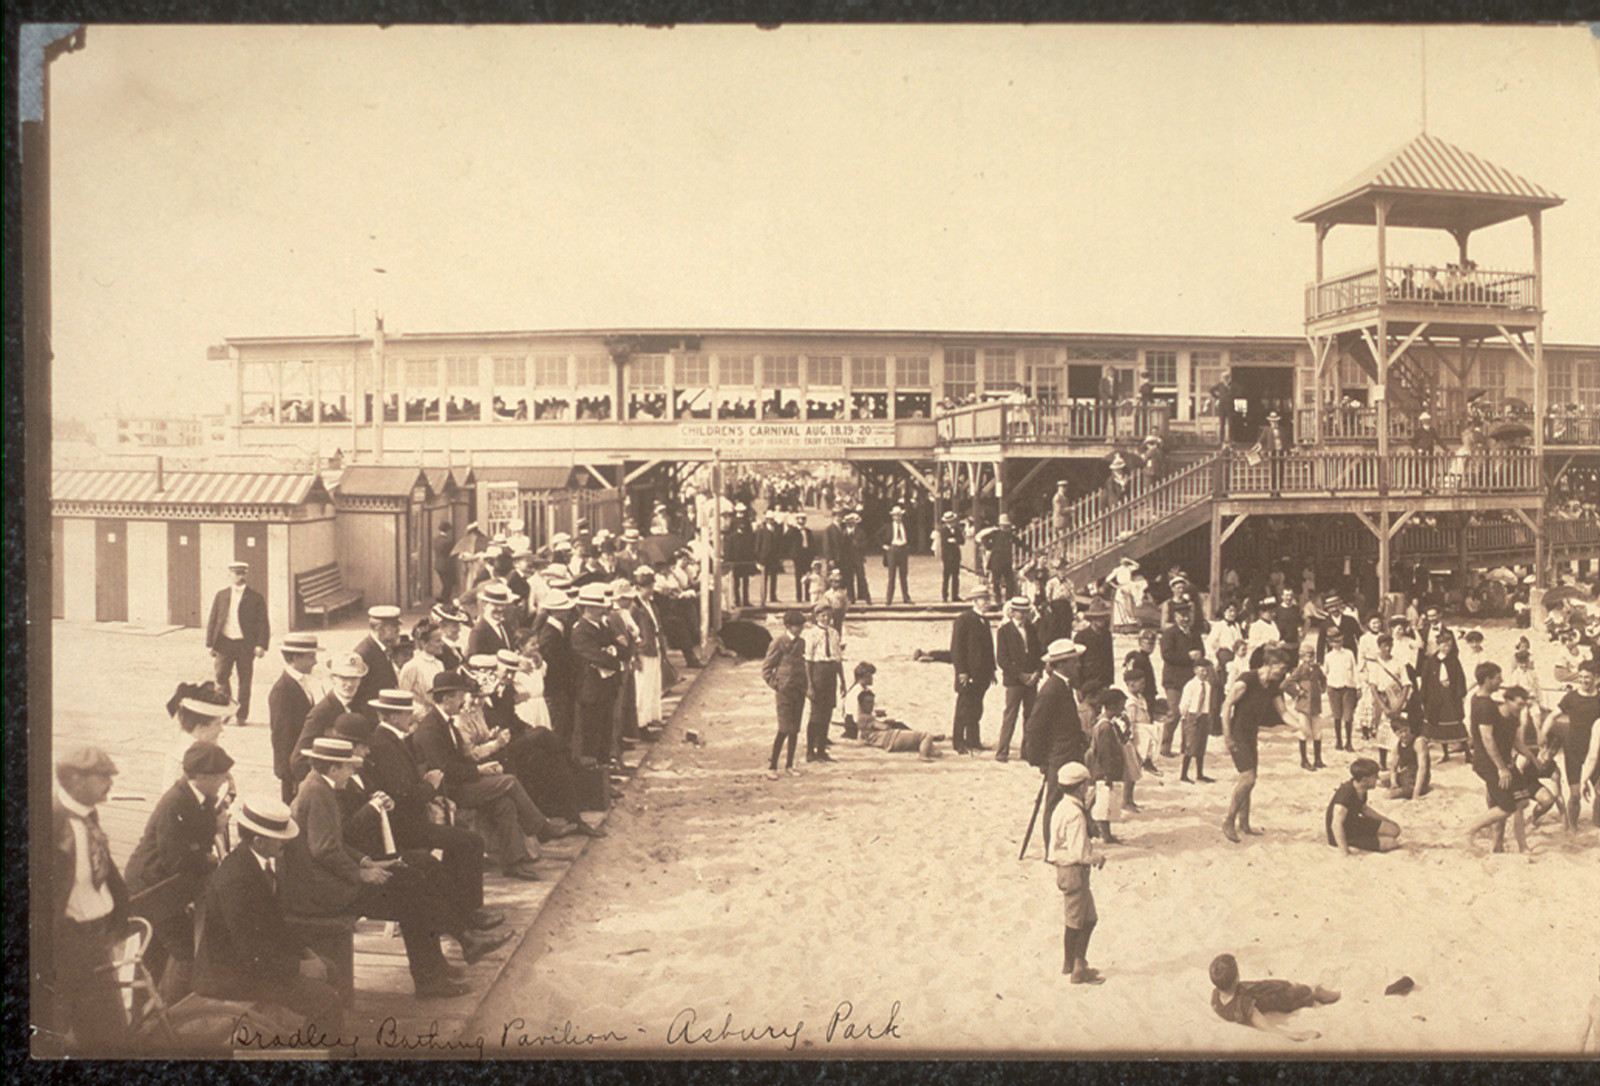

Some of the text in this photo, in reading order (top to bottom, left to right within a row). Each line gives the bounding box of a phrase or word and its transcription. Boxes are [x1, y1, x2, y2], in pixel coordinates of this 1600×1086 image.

[749, 425, 800, 436] CARNIVAL
[230, 1012, 359, 1058] Bradley
[376, 1016, 485, 1060] Bathing
[501, 1017, 628, 1048] Pavilion
[666, 1007, 804, 1051] Asbury
[826, 1000, 901, 1043] Park
